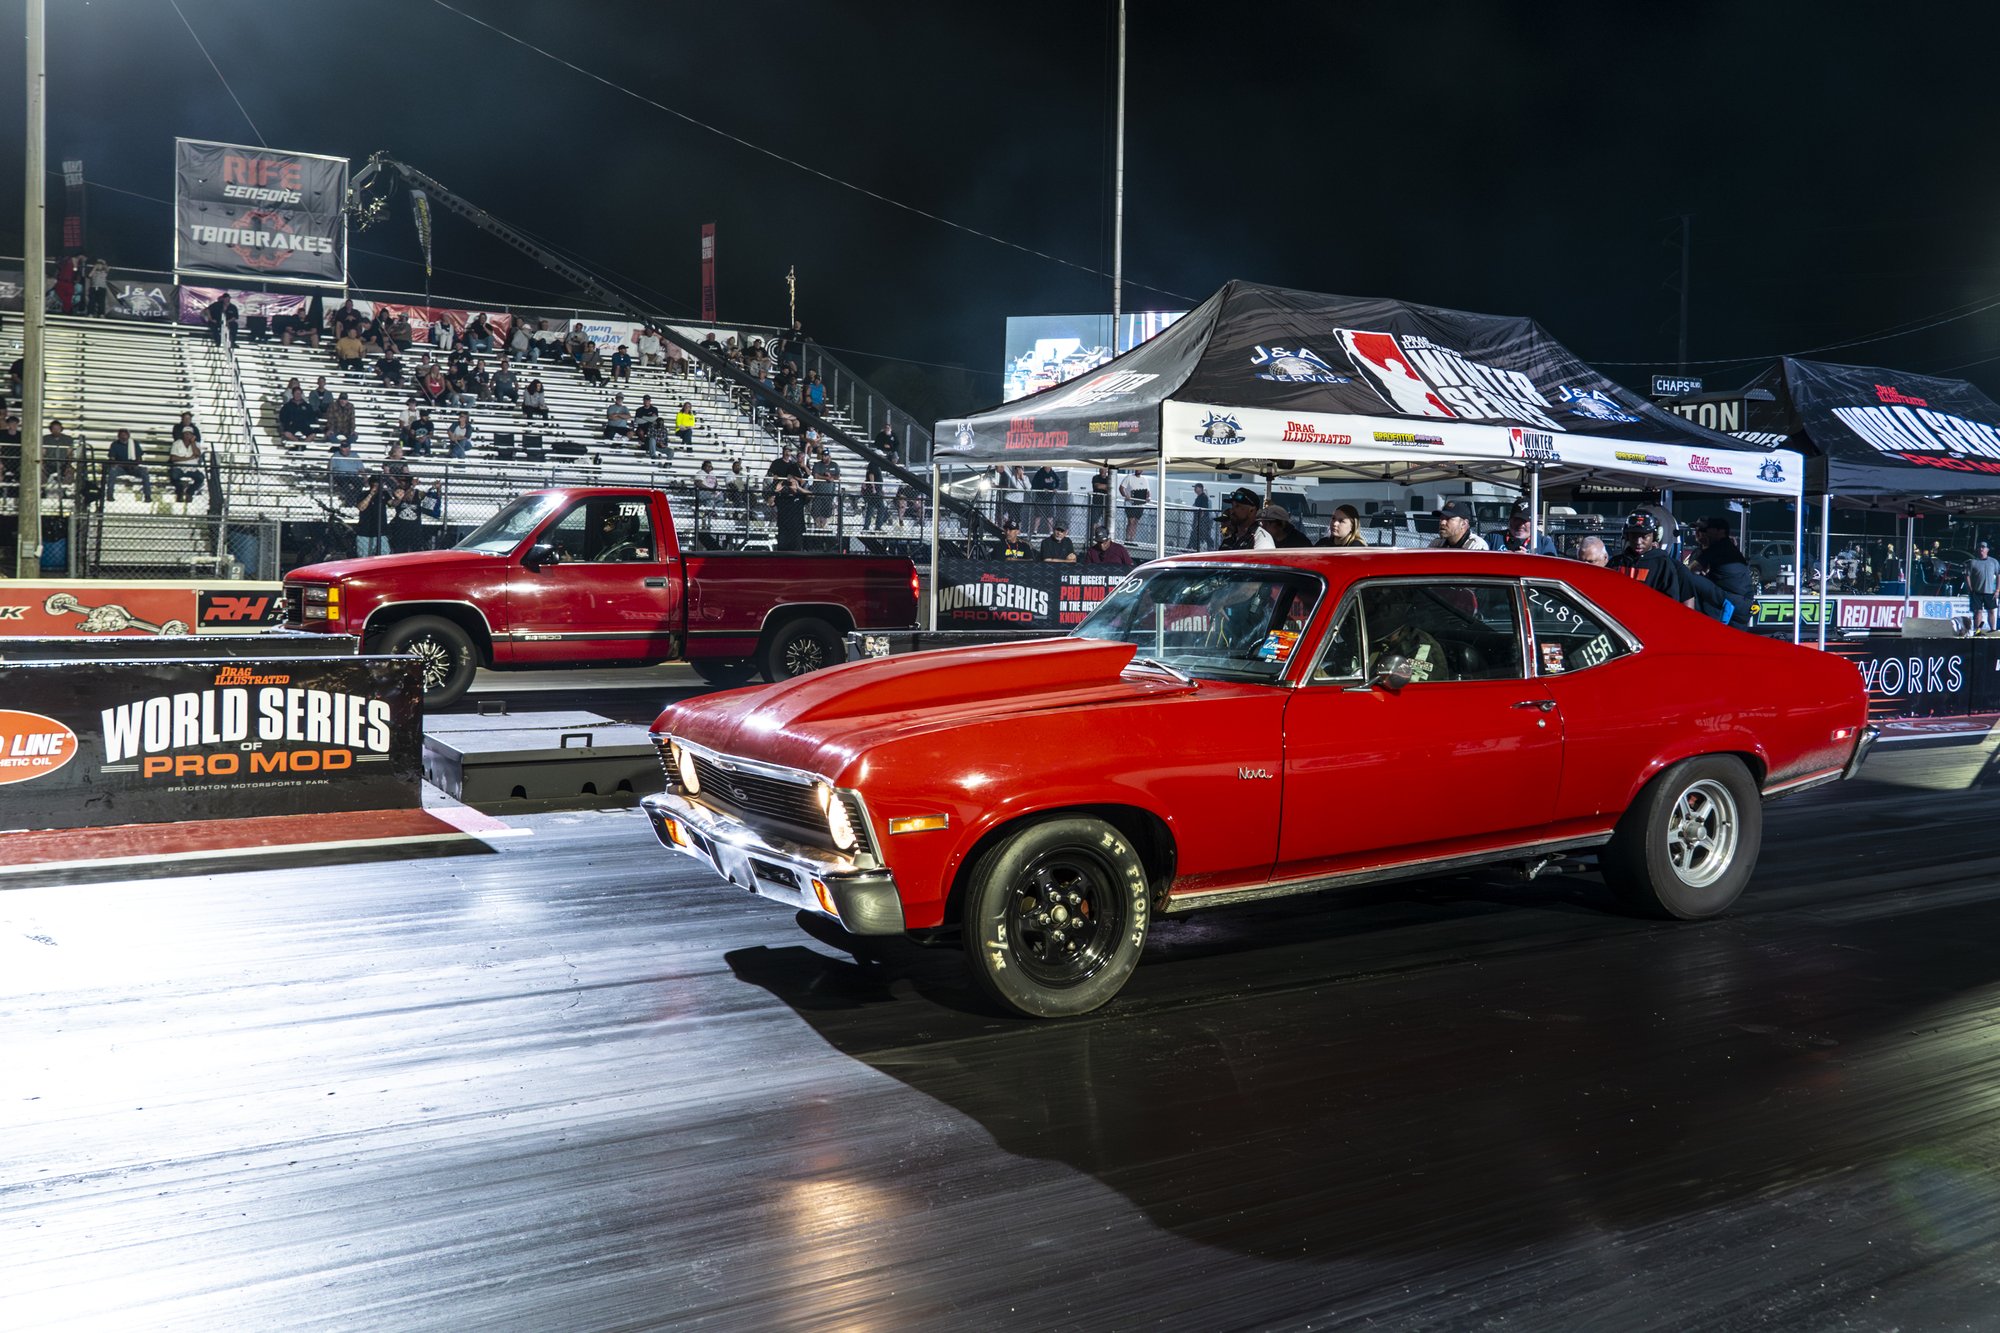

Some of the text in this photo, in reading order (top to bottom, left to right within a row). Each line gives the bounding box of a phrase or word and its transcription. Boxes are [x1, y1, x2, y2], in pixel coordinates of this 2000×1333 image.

[223, 156, 303, 190] RIFE
[223, 184, 303, 204] SENSORS
[1404, 349, 1553, 408] WINTER
[1656, 380, 1690, 392] CHAPS
[1437, 385, 1567, 431] SERIES
[1287, 421, 1315, 434] DRAG
[1831, 405, 1946, 451] WORLD
[1005, 430, 1069, 450] ILLUSTRATED
[1281, 430, 1352, 445] ILLUSTRATED
[1523, 432, 1554, 451] WINTER
[1690, 454, 1710, 466] DRAG
[1688, 463, 1733, 476] ILLUSTRATED
[1069, 575, 1080, 585] THE
[1081, 575, 1107, 587] BIGGEST,
[938, 582, 1049, 616] WORLD SERIES
[1060, 585, 1081, 601] PRO
[1083, 585, 1105, 601] MOD
[1059, 600, 1068, 612] IN
[1068, 600, 1081, 612] THE
[1528, 588, 1583, 634] 2689
[952, 611, 1033, 622] PRO MOD
[1843, 604, 1869, 629] RED
[1869, 604, 1897, 629] LINE
[220, 666, 253, 677] DRAG
[214, 675, 290, 686] ILLUSTRATED
[101, 687, 391, 764] WORLD SERIES
[10, 732, 66, 757] LINE
[239, 742, 263, 751] OF
[31, 757, 53, 766] OIL
[143, 750, 352, 778] PRO MOD
[1238, 766, 1273, 780] Nova
[167, 783, 228, 792] BRADENTON
[230, 780, 302, 789] MOTORSPORTS
[1100, 831, 1126, 856] ET
[1125, 863, 1148, 948] FRONT
